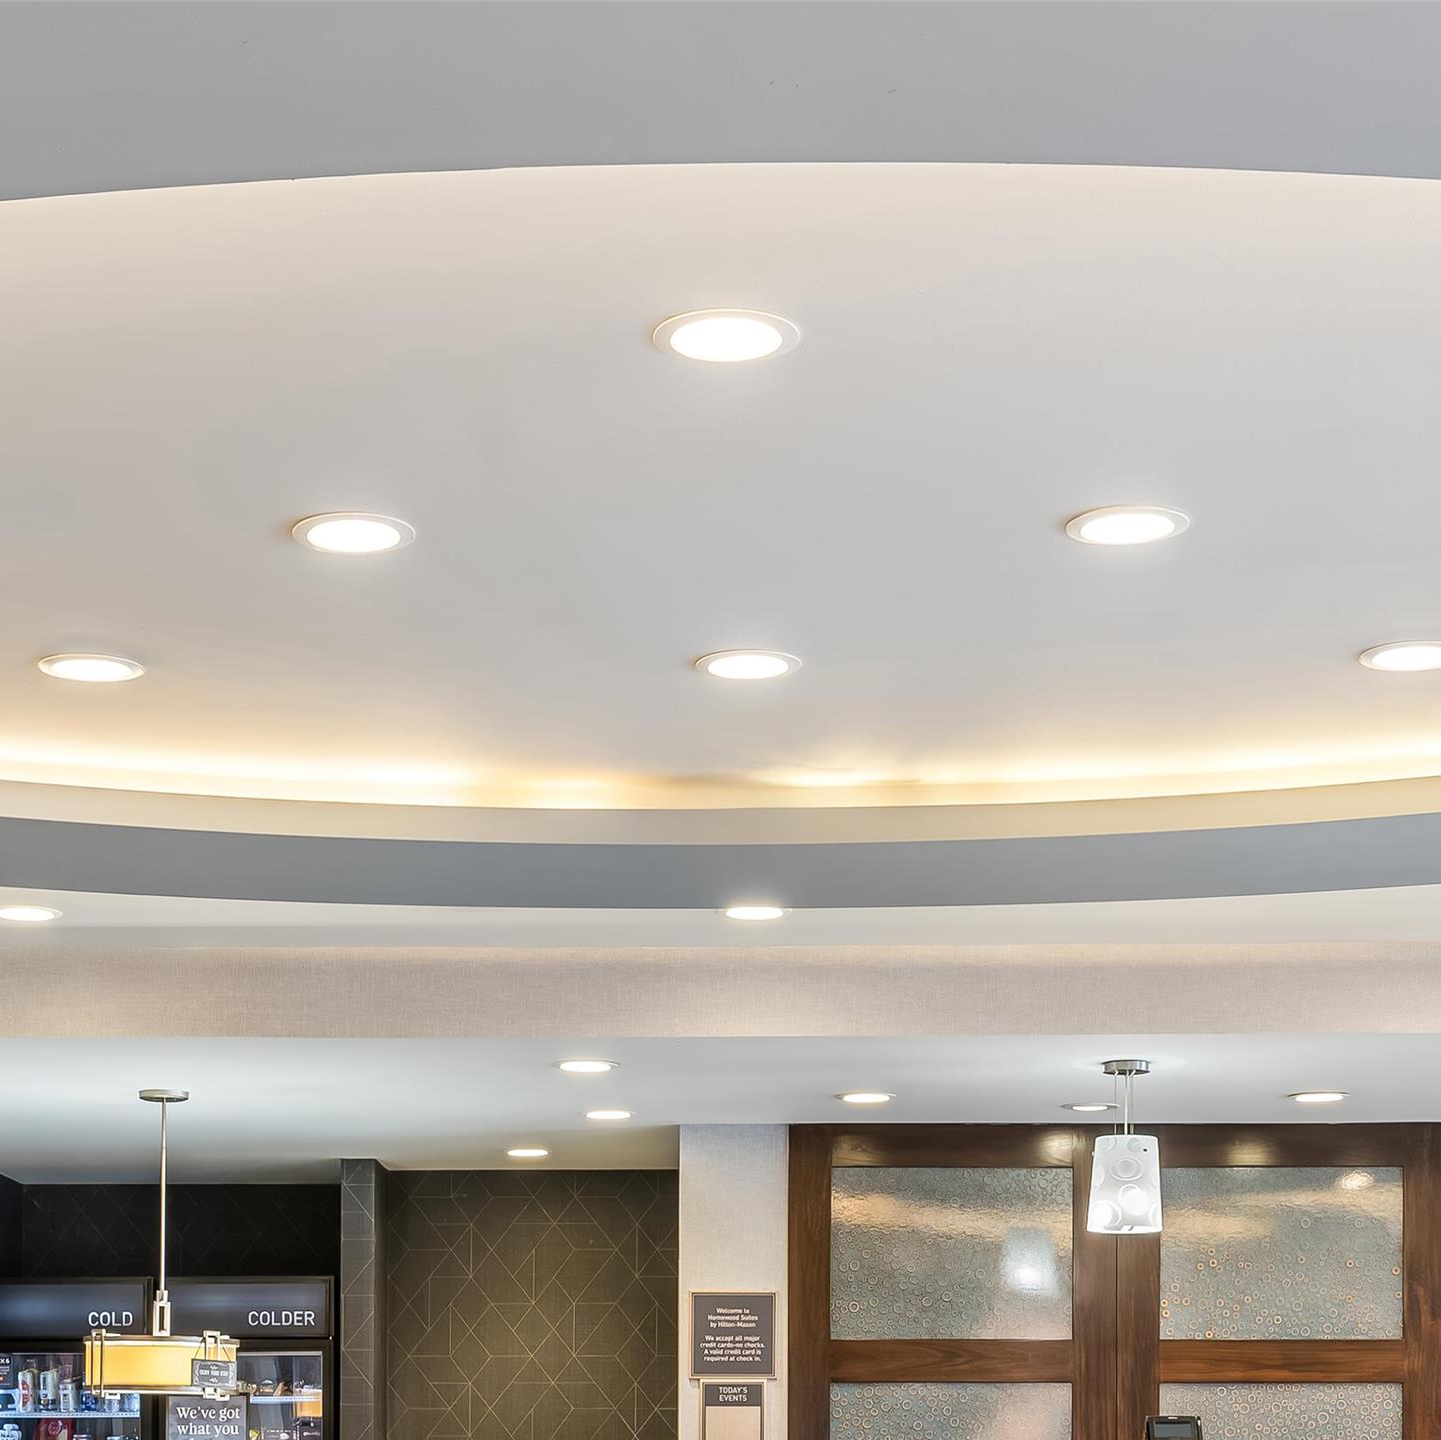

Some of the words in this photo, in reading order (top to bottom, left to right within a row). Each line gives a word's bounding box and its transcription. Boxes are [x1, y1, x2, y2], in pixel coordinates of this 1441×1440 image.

[88, 1312, 134, 1326] COLD
[248, 1311, 316, 1326] COLDER
[176, 1406, 216, 1419] We've
[219, 1407, 240, 1422] got
[177, 1423, 211, 1435] what
[214, 1424, 239, 1437] you
